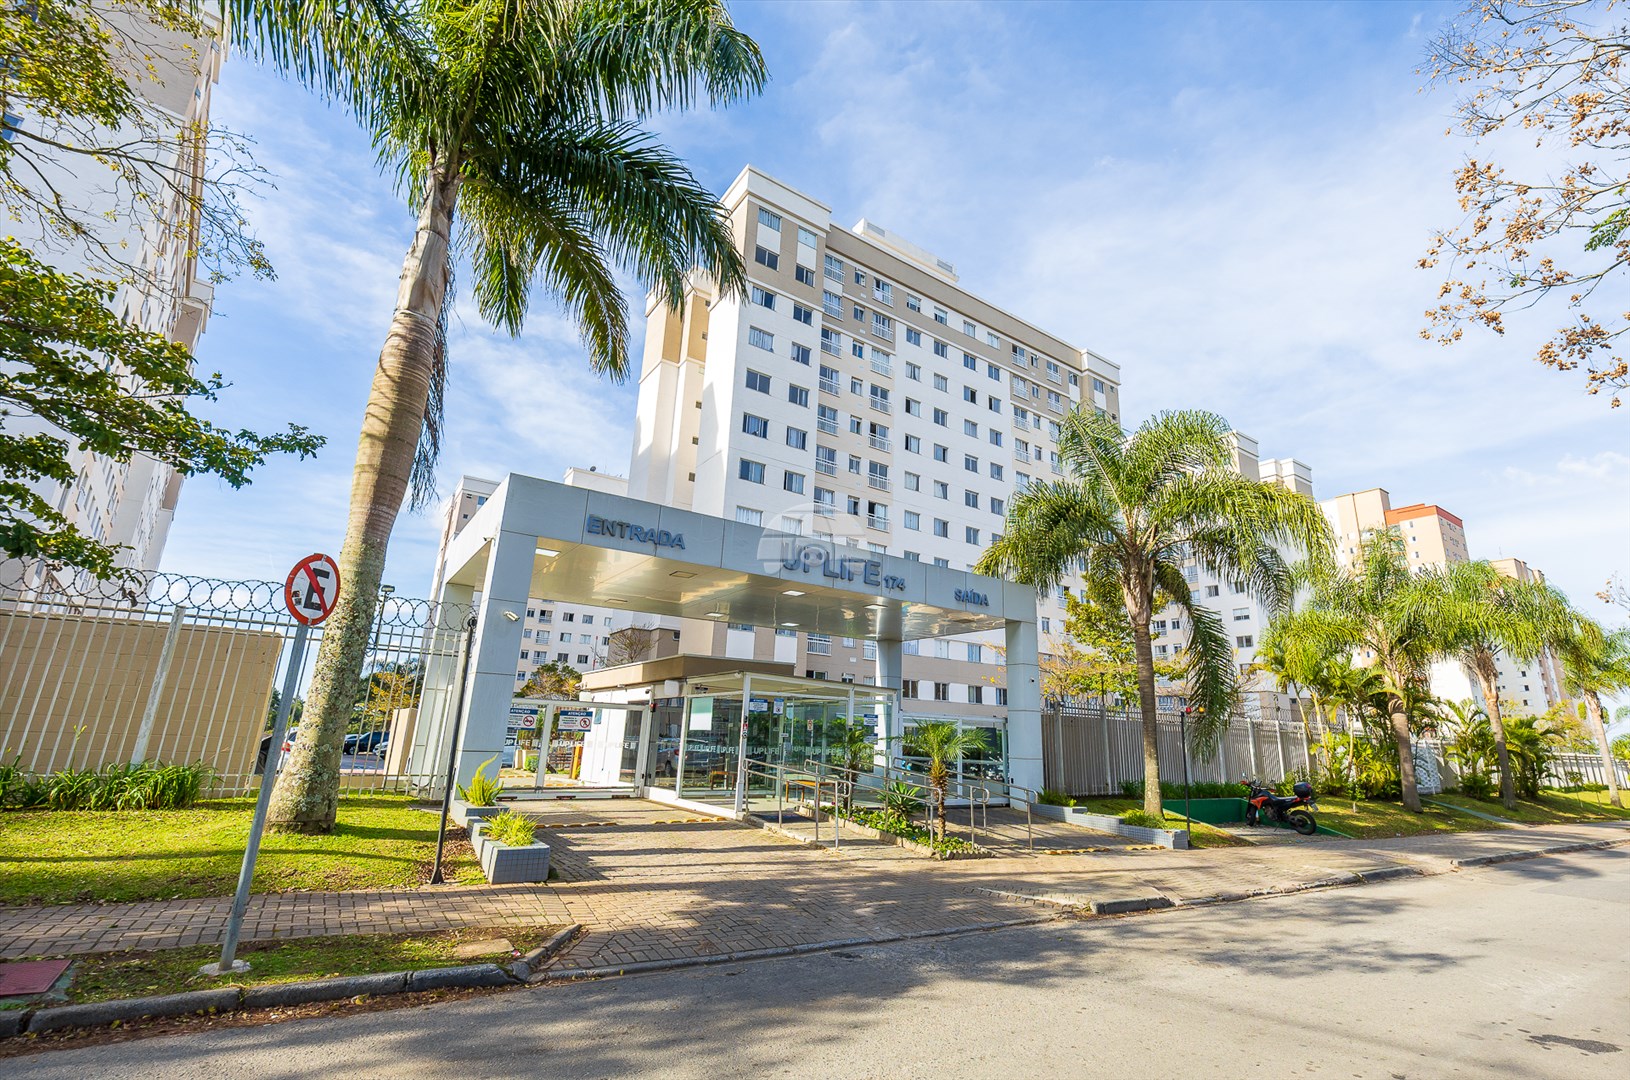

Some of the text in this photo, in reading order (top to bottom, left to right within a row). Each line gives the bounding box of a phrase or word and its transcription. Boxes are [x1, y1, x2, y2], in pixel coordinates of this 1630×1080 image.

[587, 514, 685, 550] ENTRADA
[303, 568, 330, 611] E
[884, 574, 906, 591] 174
[953, 586, 989, 607] SAÍDA
